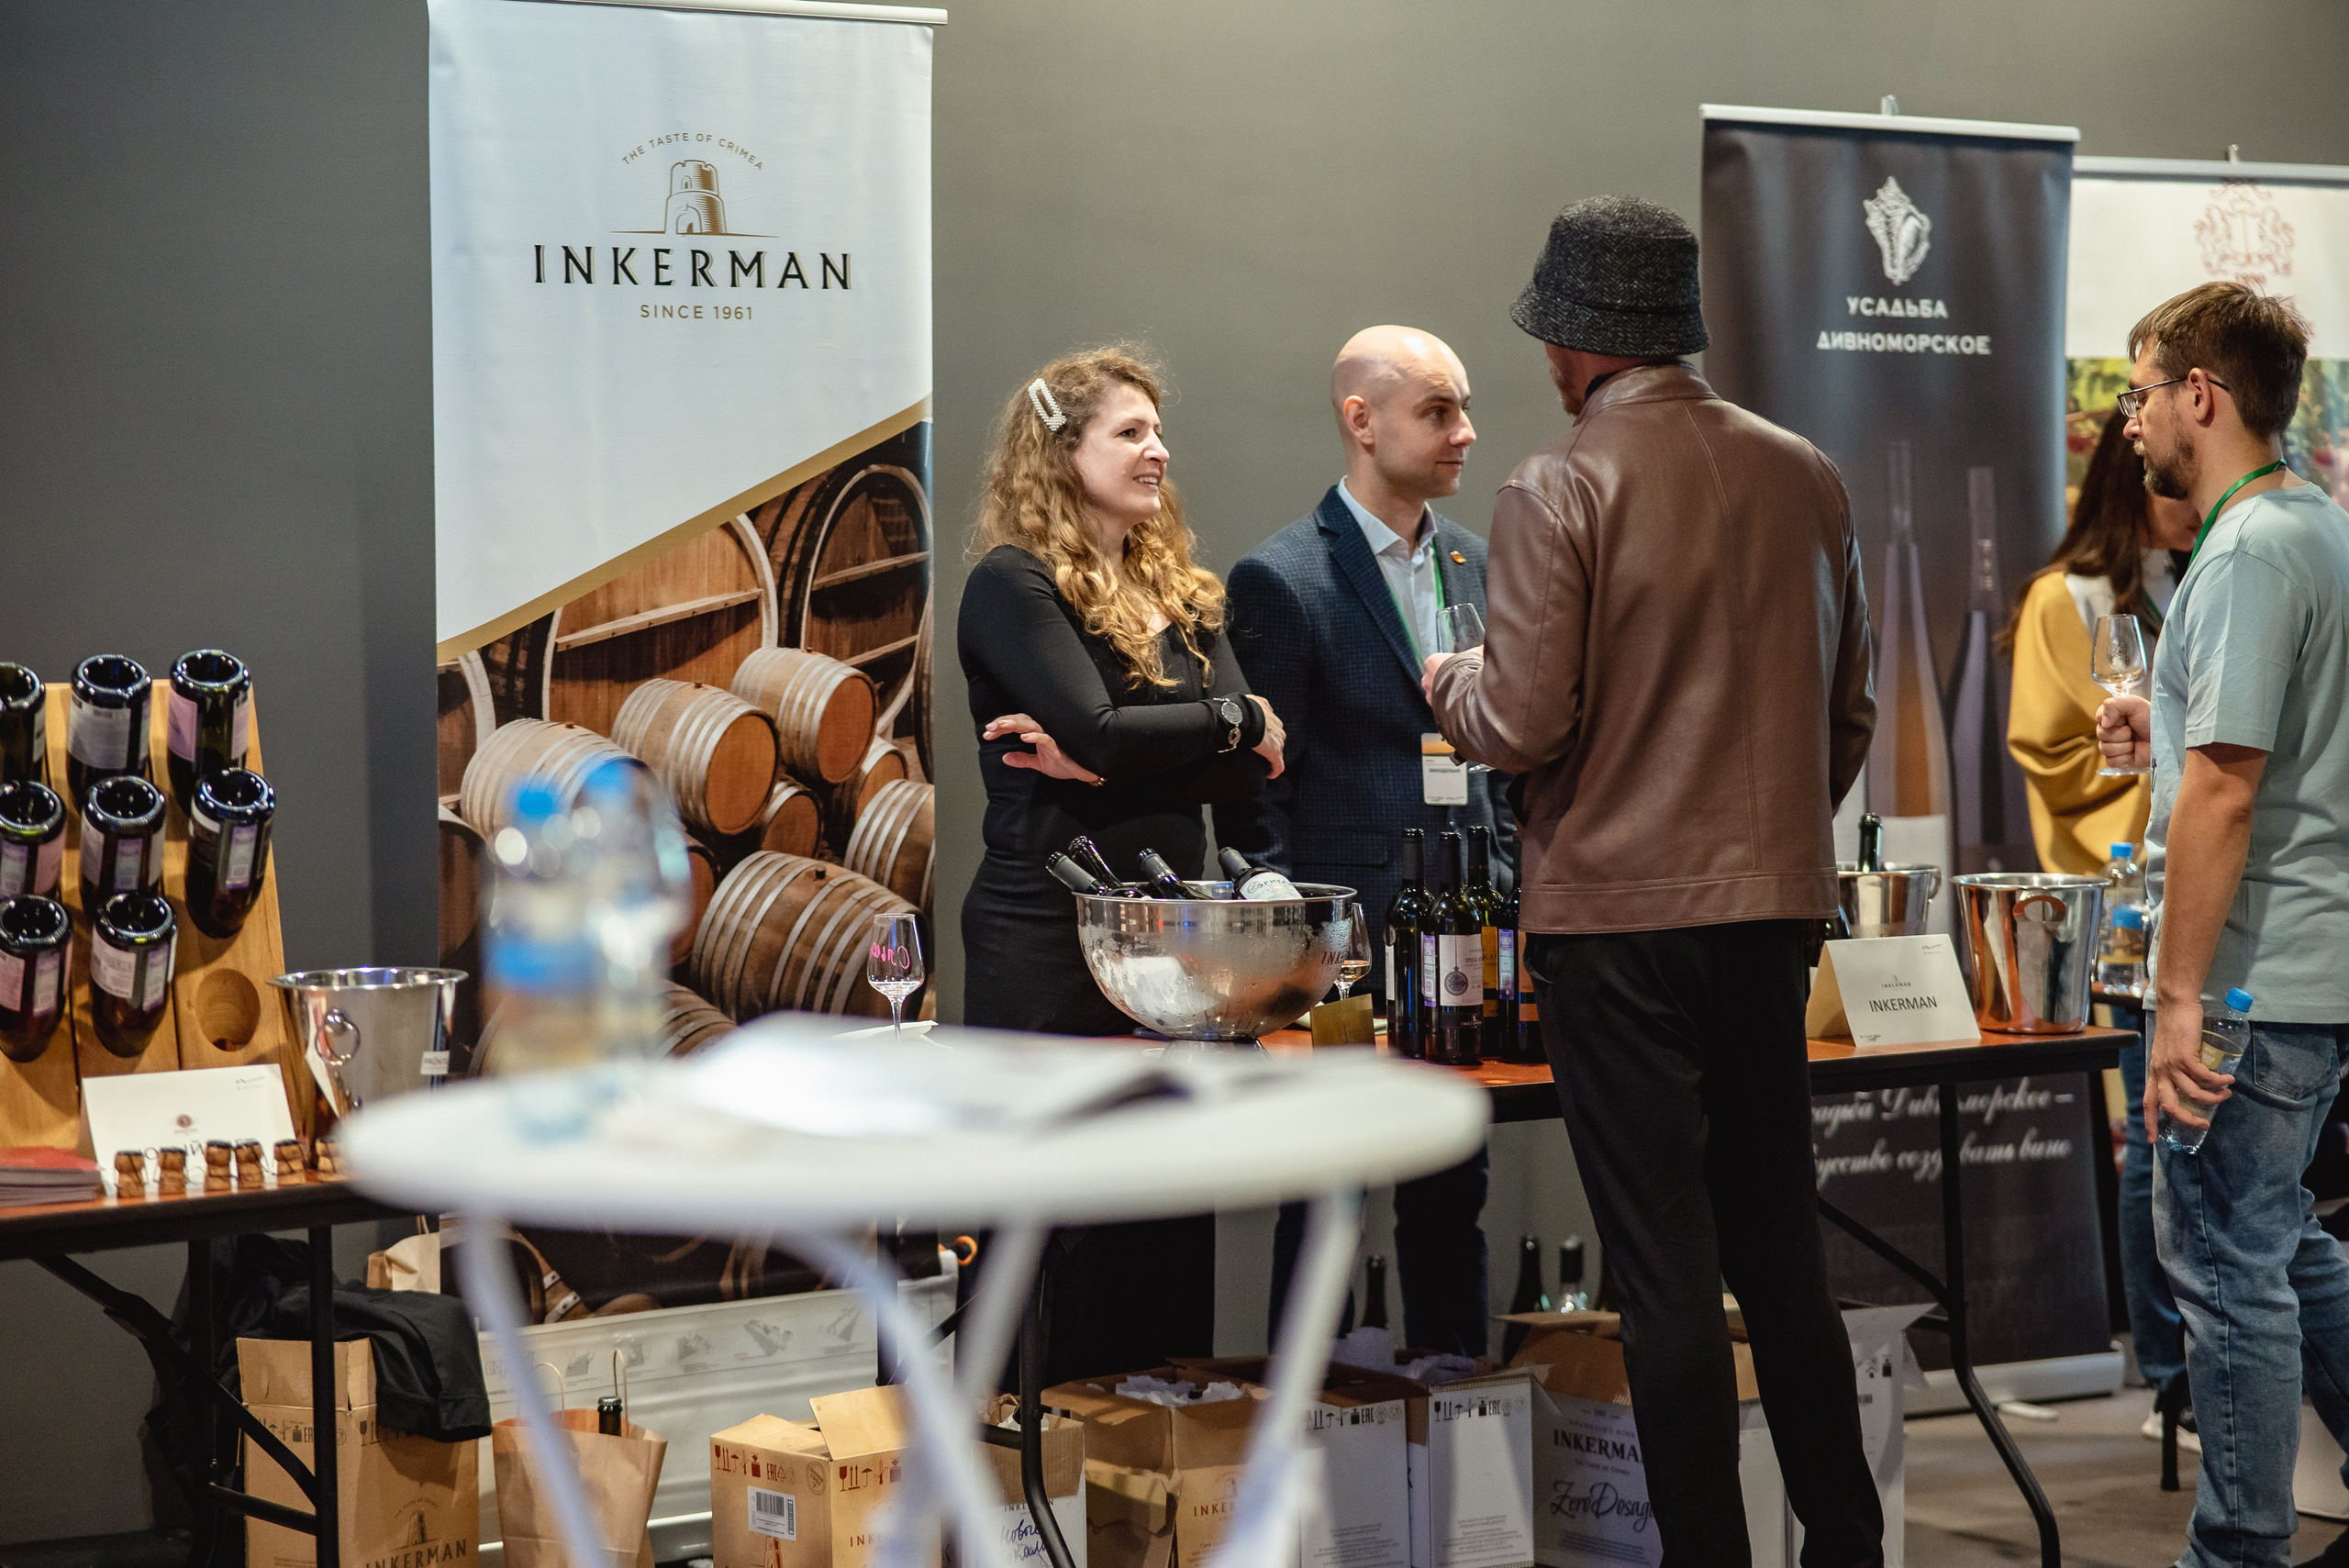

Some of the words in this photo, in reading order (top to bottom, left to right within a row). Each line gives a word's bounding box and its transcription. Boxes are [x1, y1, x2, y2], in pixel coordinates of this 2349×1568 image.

[621, 145, 646, 165] THE
[648, 132, 689, 149] TASTE
[696, 133, 713, 142] OF
[718, 139, 763, 171] CRIMEA
[533, 244, 852, 290] INKERMAN
[640, 305, 704, 319] SINCE
[713, 306, 753, 320] 1961
[1846, 296, 1949, 319] УСАДЬБА
[1816, 330, 1992, 355] ДИВНОМОРСКОЕ
[1869, 995, 1938, 1013] INKERMAN
[304, 1427, 314, 1443] EA
[1553, 1429, 1644, 1463] INKERMA
[1004, 1498, 1054, 1512] INKEN
